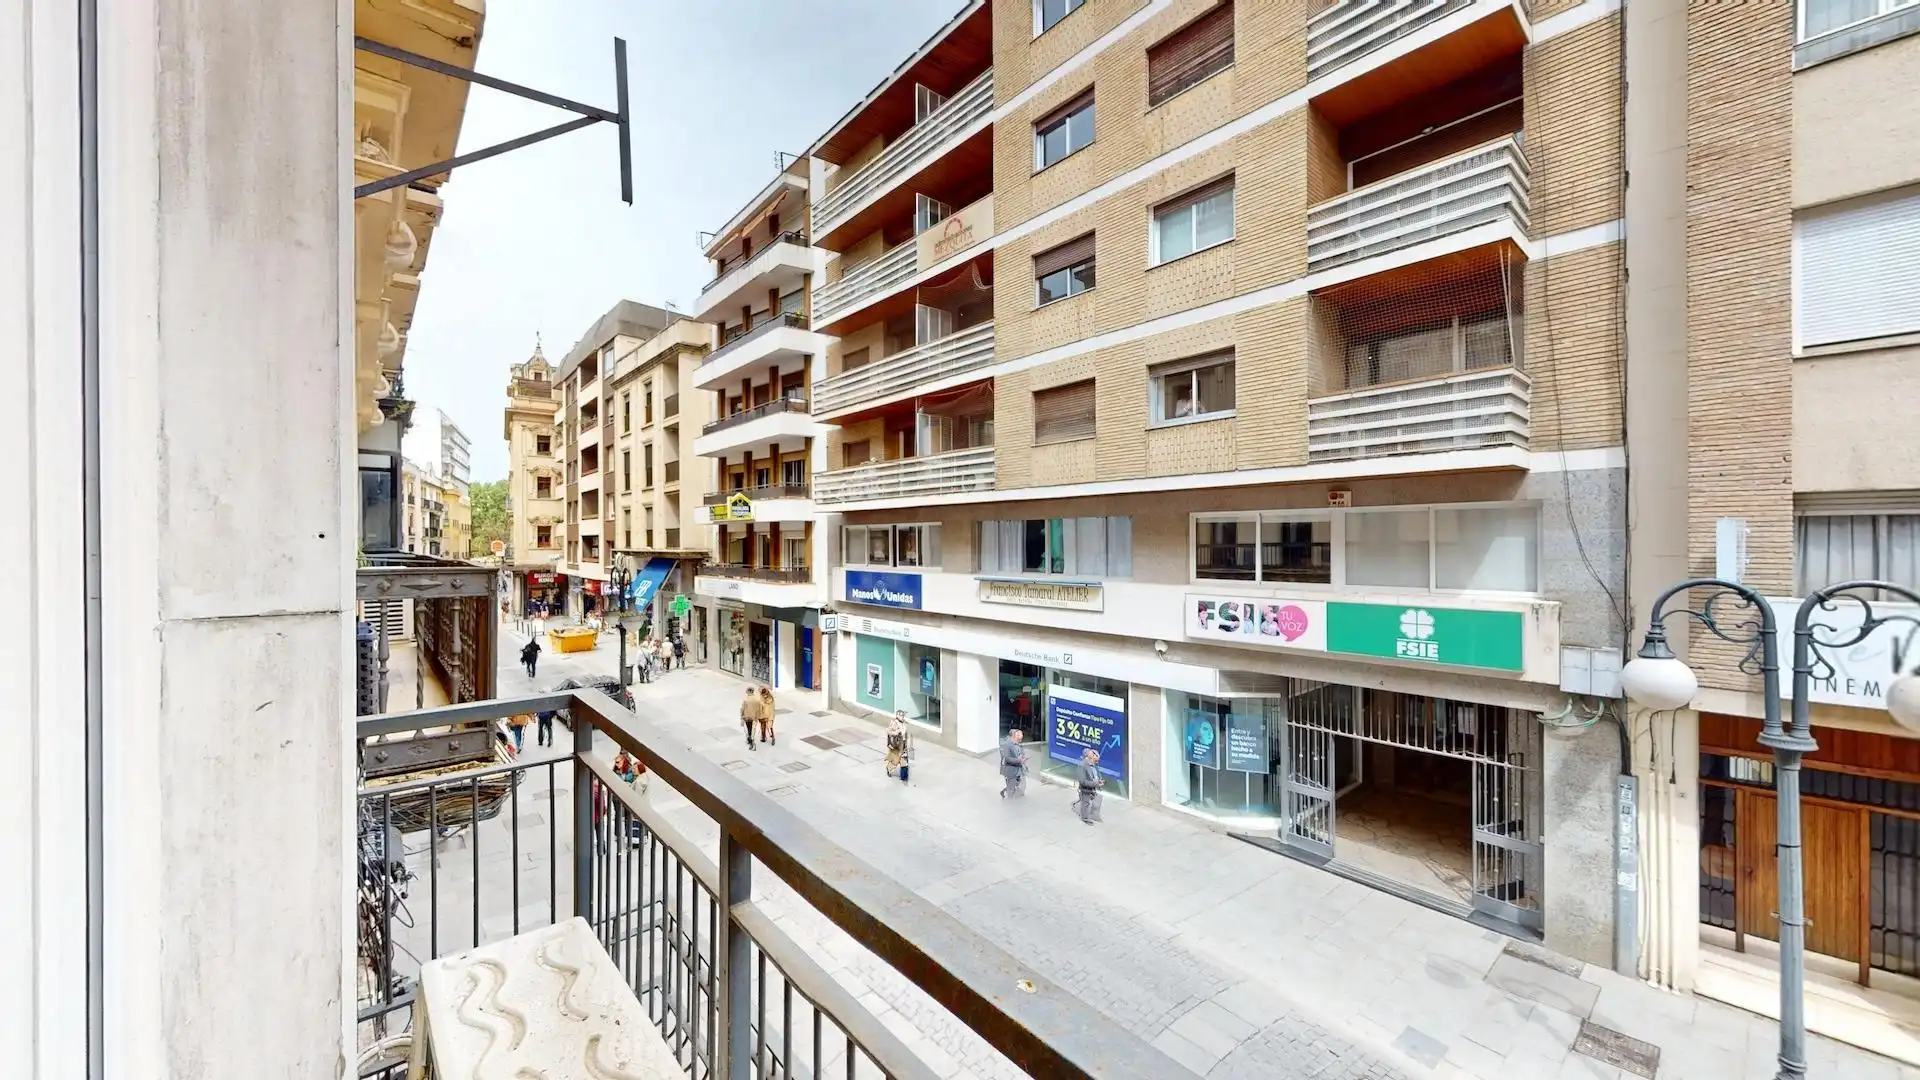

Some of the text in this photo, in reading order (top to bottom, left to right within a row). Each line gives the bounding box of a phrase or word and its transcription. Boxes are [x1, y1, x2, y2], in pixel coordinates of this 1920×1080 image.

[852, 588, 913, 604] Manos Unidas
[1057, 586, 1089, 603] ATELIER
[1198, 600, 1280, 636] FSIE
[1282, 611, 1293, 621] TU
[1281, 622, 1304, 633] VOZ
[1014, 648, 1060, 664] Deutsche Bank
[1396, 640, 1439, 658] FSIE
